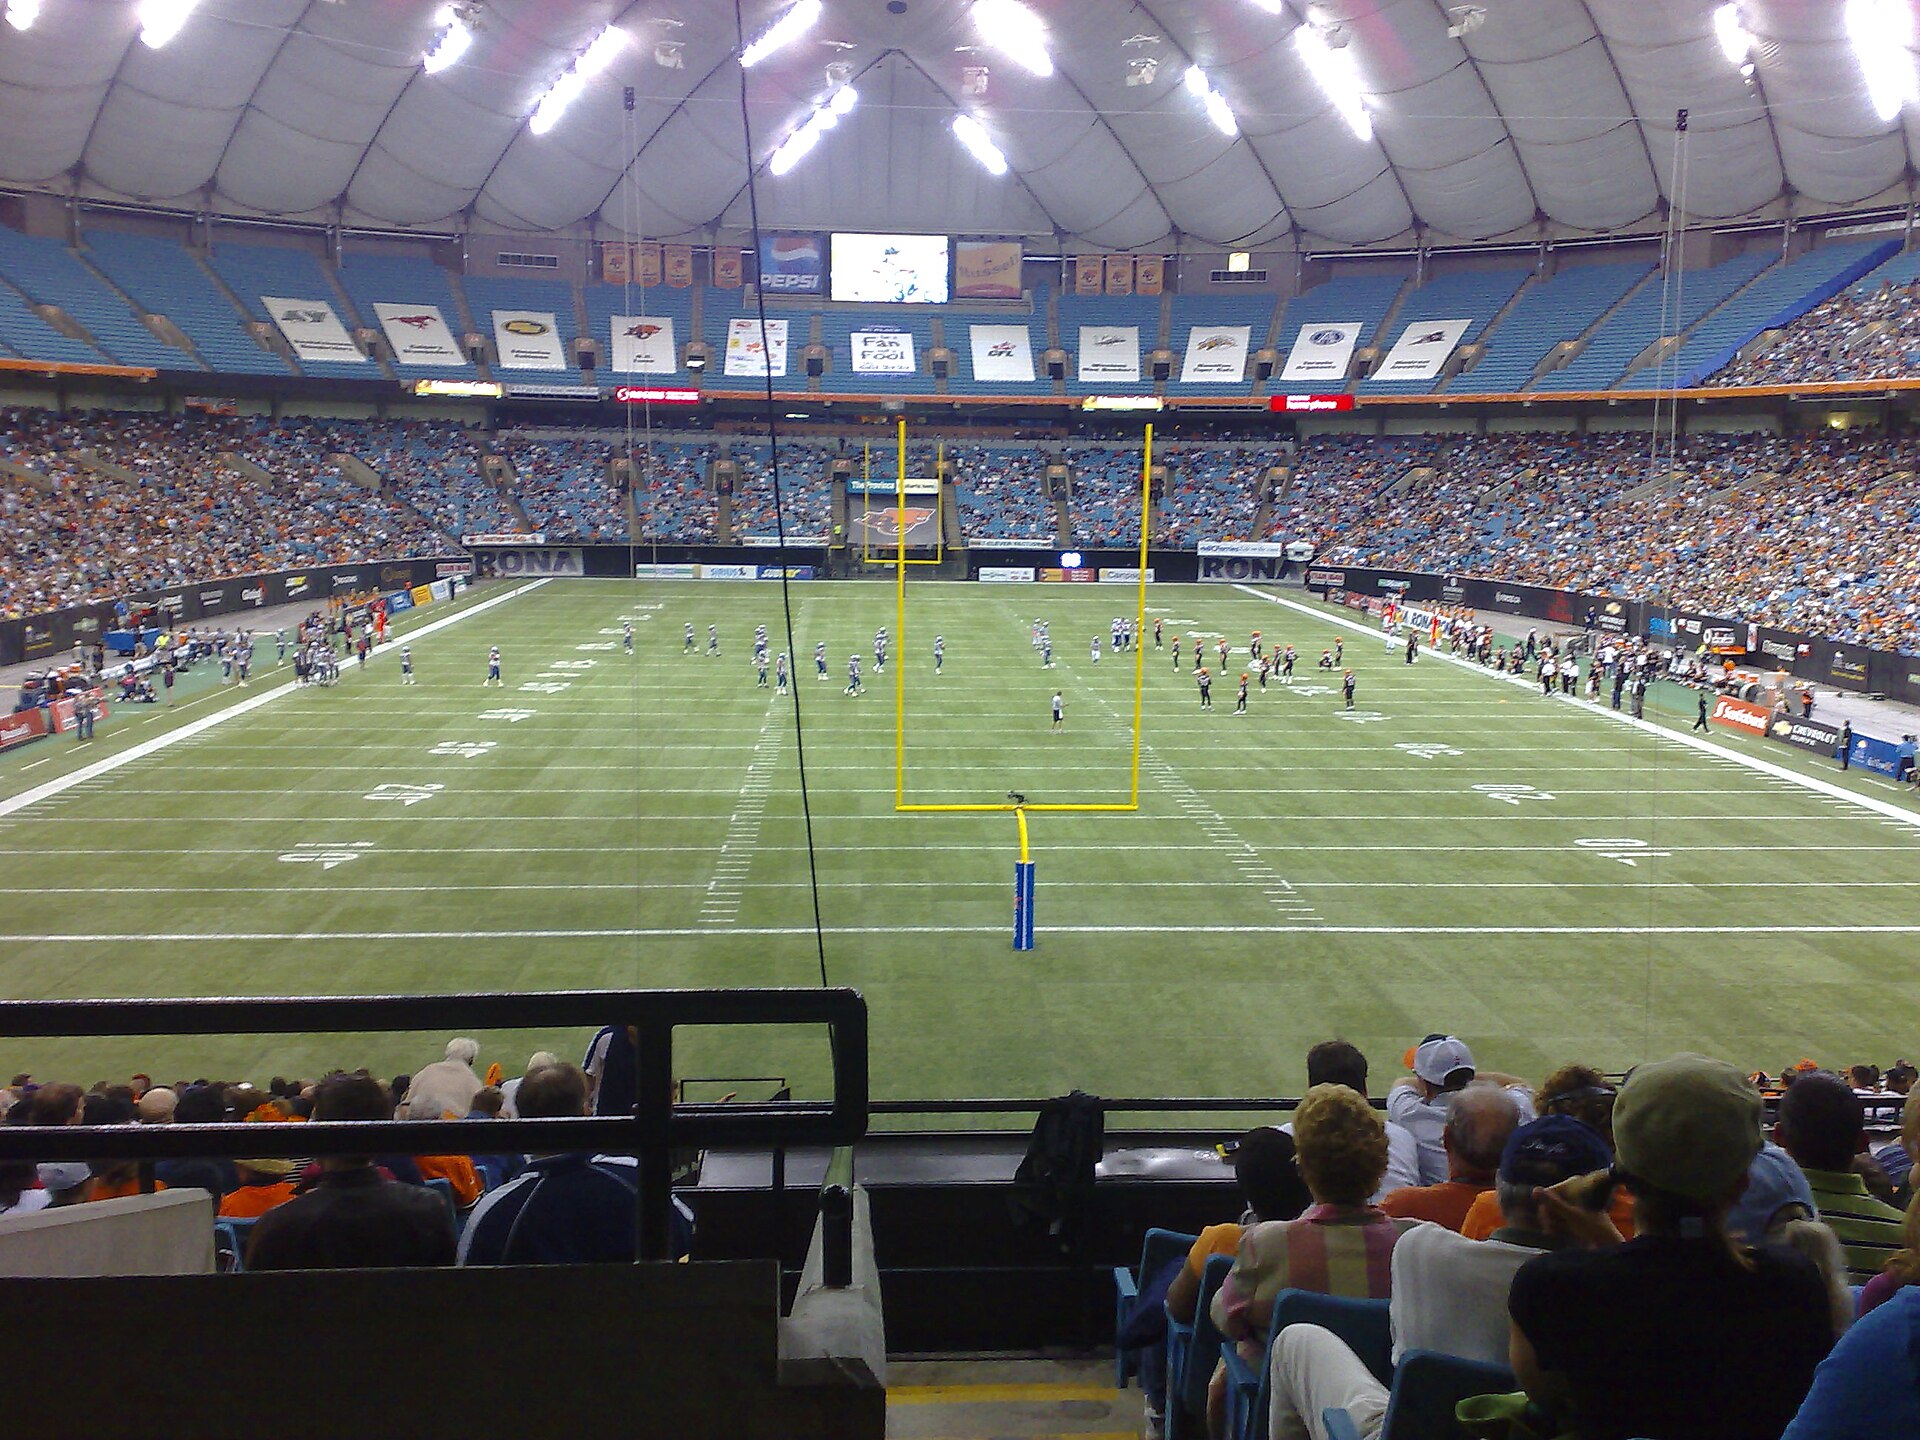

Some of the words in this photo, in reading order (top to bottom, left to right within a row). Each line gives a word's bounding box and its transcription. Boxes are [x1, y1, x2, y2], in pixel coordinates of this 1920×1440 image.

[759, 274, 820, 288] PEPSI
[862, 335, 901, 348] Fan
[860, 350, 905, 360] Fool
[475, 551, 578, 573] RONA
[1203, 556, 1299, 580] RONA
[1722, 705, 1768, 730] Scotiabank
[1792, 724, 1838, 745] CHEVROLET
[1573, 838, 1672, 858] 10
